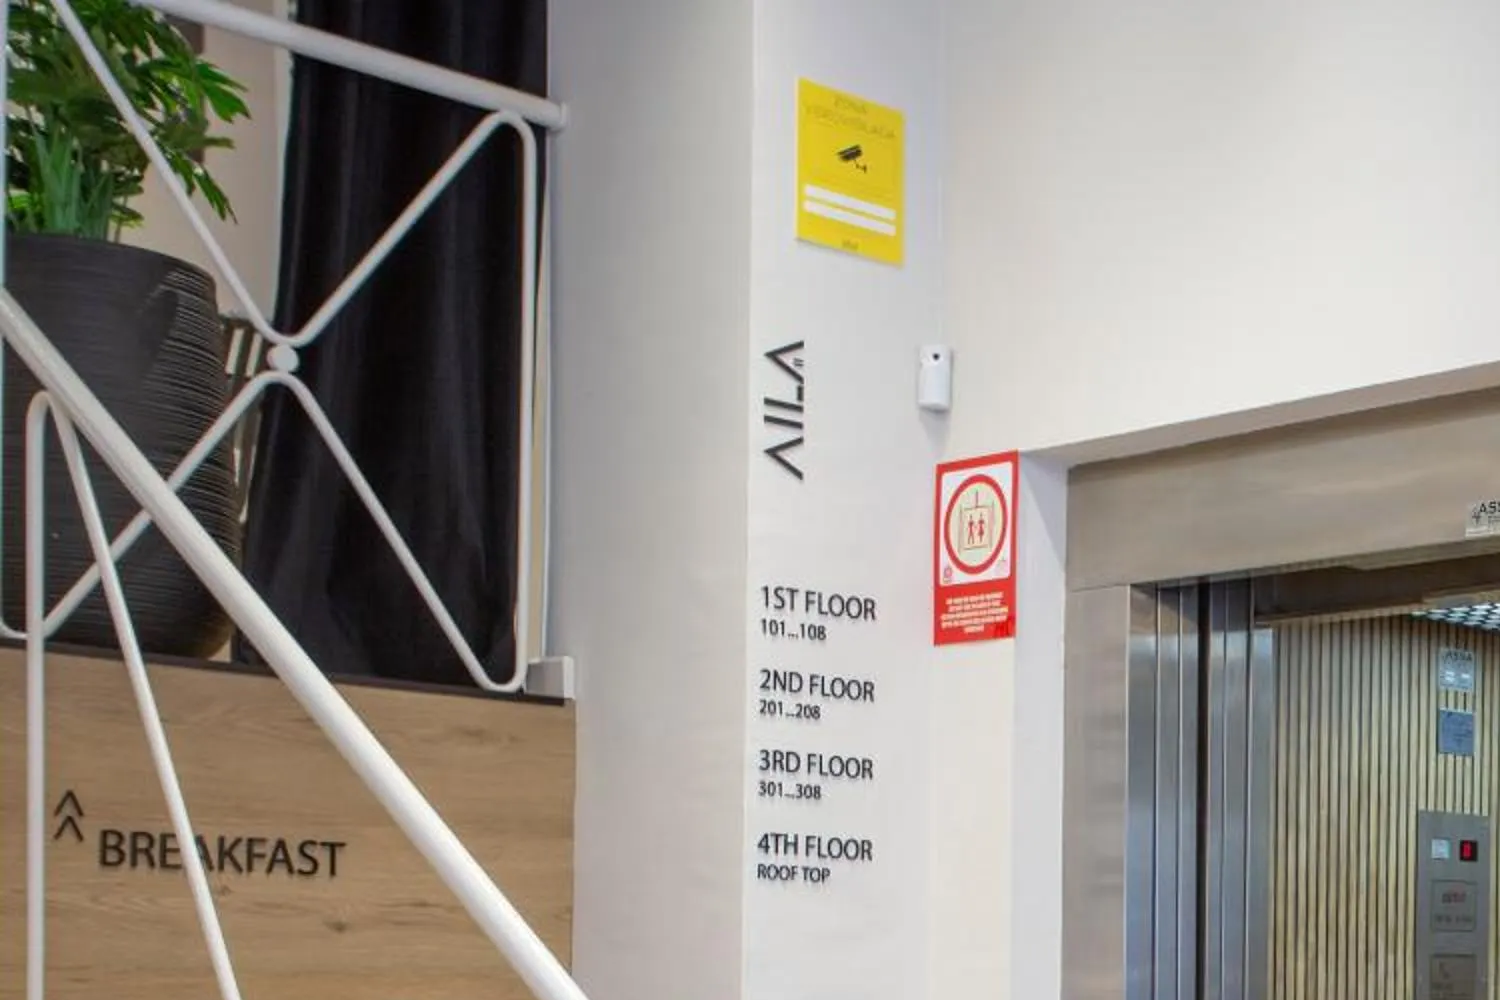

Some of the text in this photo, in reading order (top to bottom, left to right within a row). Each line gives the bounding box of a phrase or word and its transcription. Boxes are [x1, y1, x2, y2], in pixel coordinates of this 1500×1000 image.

[761, 585, 877, 621] 1ST FLOOR
[760, 669, 876, 702] 2ND FLOOR
[759, 749, 874, 780] 3RD FLOOR
[757, 833, 874, 862] 4TH FLOOR
[757, 863, 832, 884] ROOF TOP
